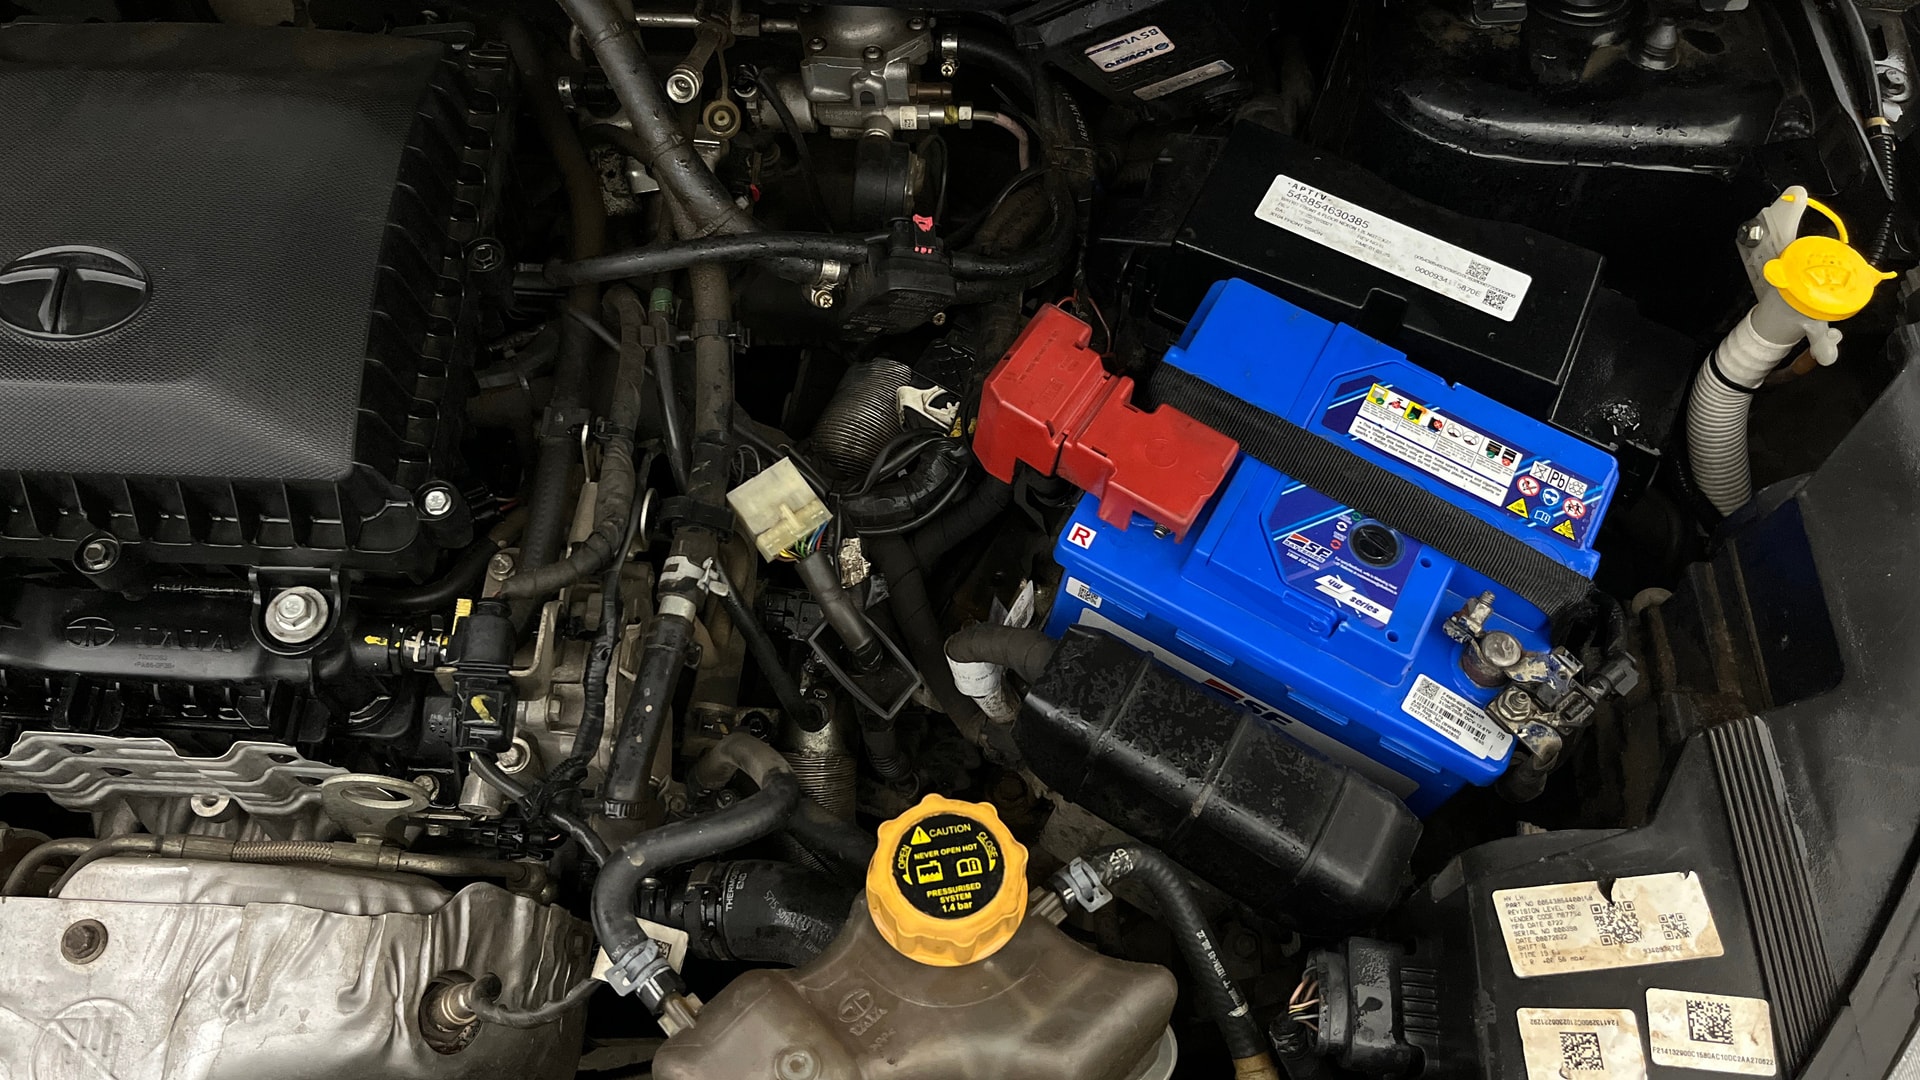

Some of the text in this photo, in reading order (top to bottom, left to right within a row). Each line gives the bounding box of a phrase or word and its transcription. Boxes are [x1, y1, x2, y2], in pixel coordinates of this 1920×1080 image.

[1104, 47, 1155, 69] LOVATO
[1291, 182, 1327, 201] APTIV
[1285, 188, 1370, 229] 543854630385
[1372, 437, 1388, 447] Battery
[1371, 431, 1386, 441] Charge
[1394, 443, 1408, 452] battery
[1450, 470, 1464, 479] places
[1371, 426, 1385, 436] battery
[1385, 433, 1405, 445] generates
[1404, 443, 1425, 455] hydrogen
[1481, 481, 1502, 492] cigarettes
[1550, 472, 1565, 490] Pb
[1072, 527, 1090, 546] R
[1284, 540, 1323, 562] BATTERIES
[1305, 541, 1330, 560] SF
[1349, 594, 1379, 615] series
[1439, 695, 1462, 712] Charging
[928, 823, 972, 838] CAUTION
[914, 843, 978, 860] NEVER OPEN HOT
[978, 831, 998, 858] CLOSE
[898, 844, 911, 869] OPEN
[926, 882, 982, 898] PRESSURISED
[940, 892, 972, 904] SYSTEM
[942, 901, 973, 912] 1.4 bar
[1507, 907, 1540, 915] REVISION
[1542, 904, 1563, 912] LEVEL
[1517, 943, 1537, 951] SHIFT
